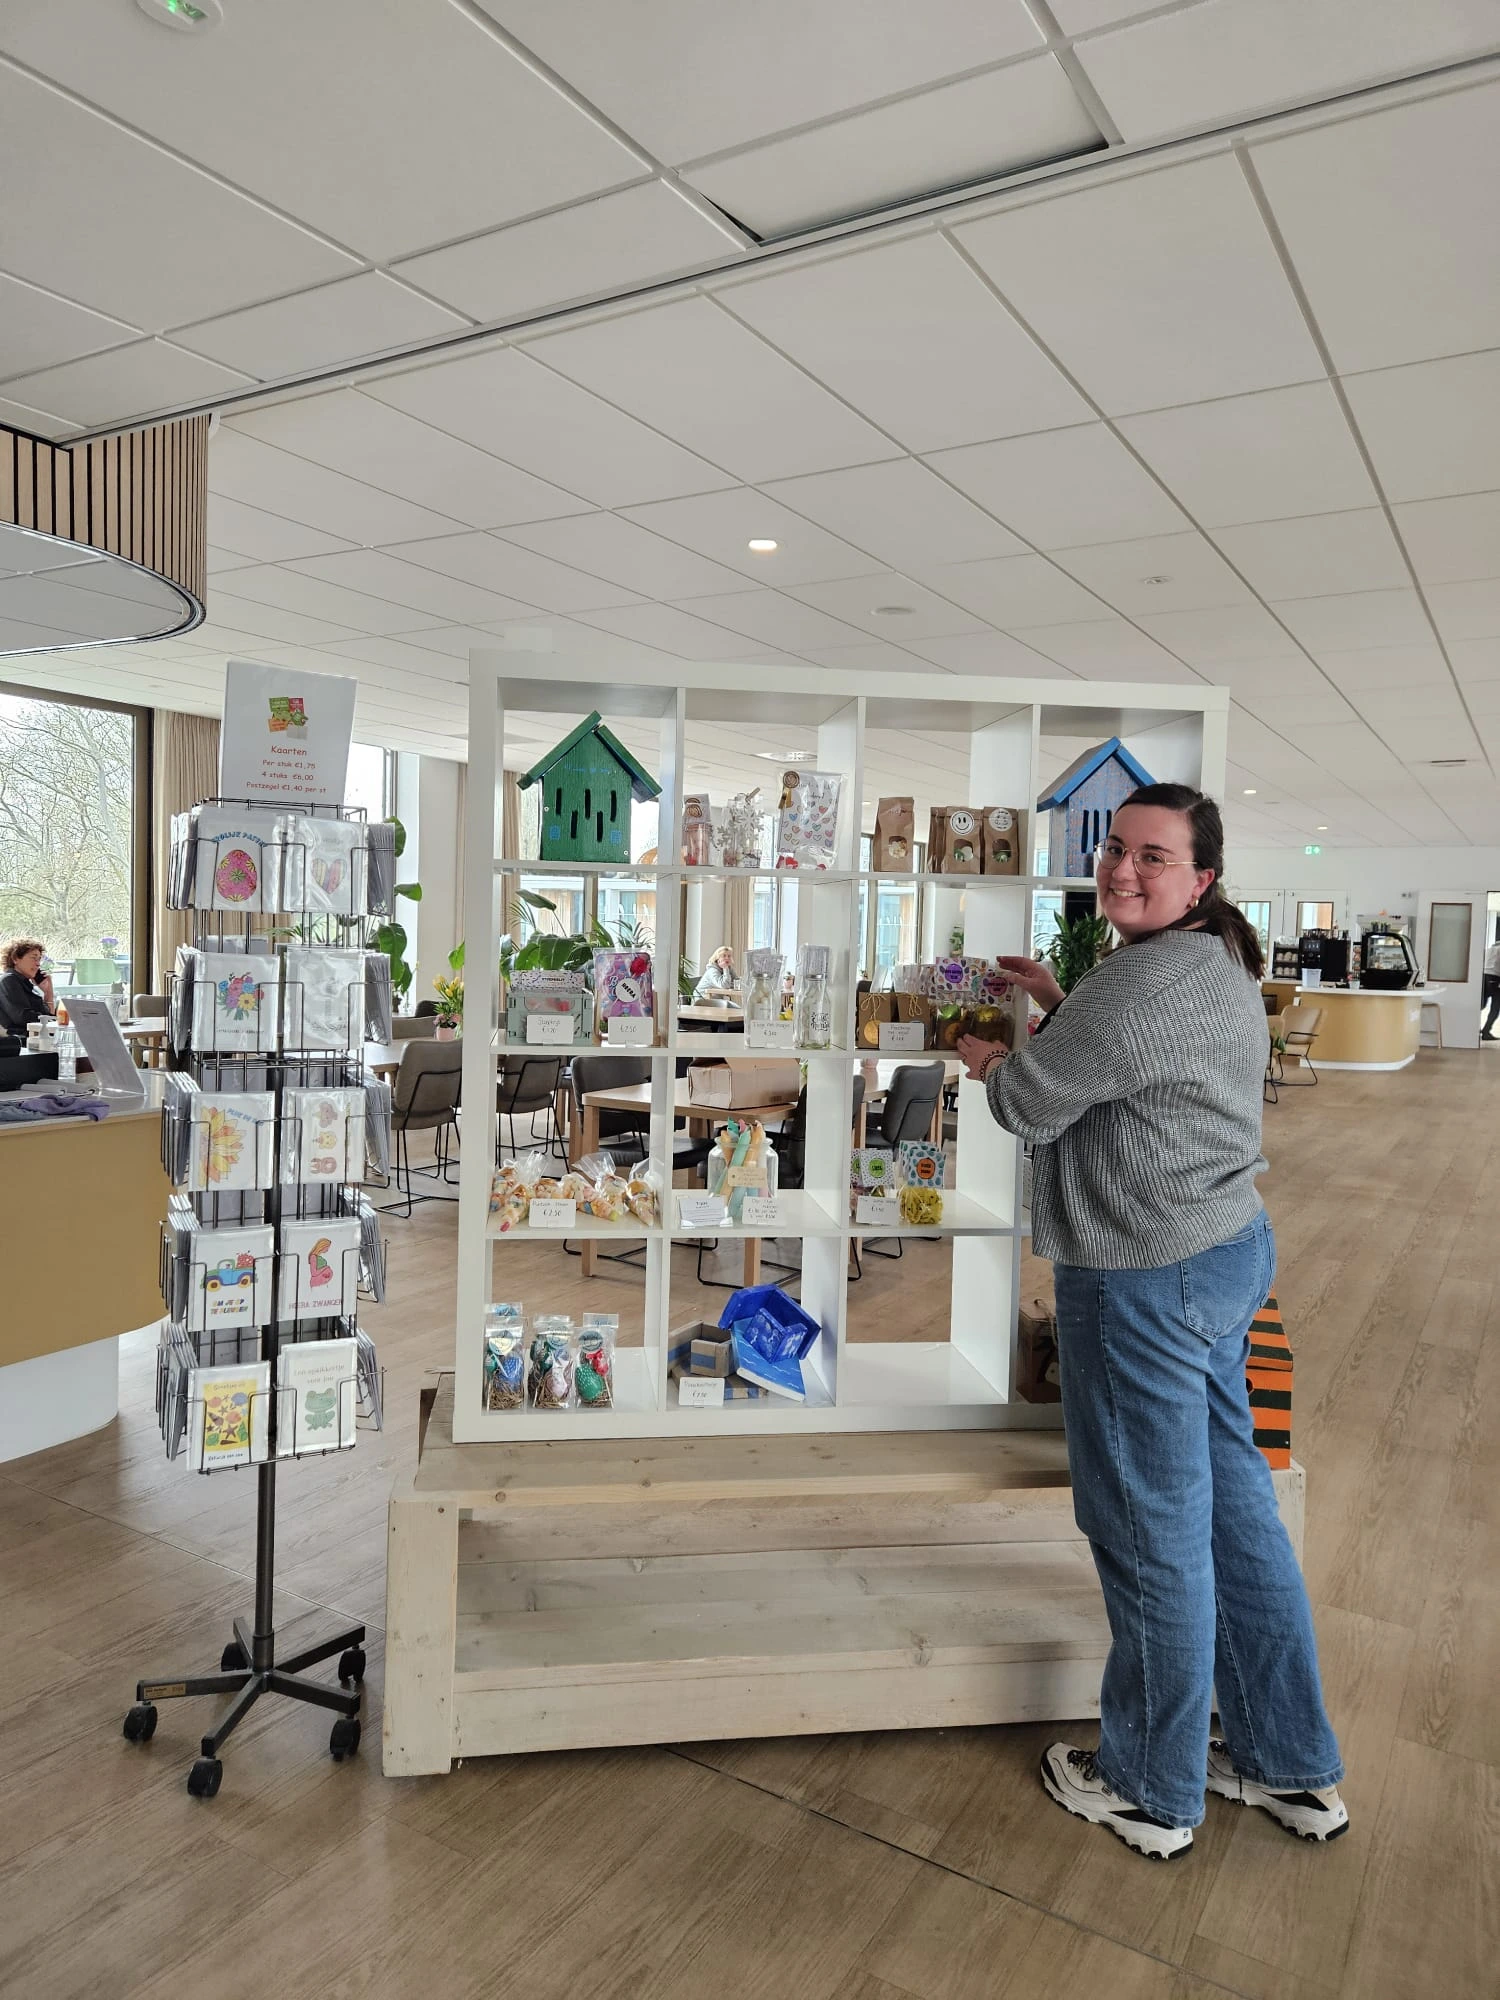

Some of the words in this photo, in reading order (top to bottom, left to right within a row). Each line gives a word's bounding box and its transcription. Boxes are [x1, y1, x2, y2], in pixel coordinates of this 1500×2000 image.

[271, 745, 307, 756] Kaarten
[246, 781, 280, 791] Postzegel
[621, 982, 637, 999] HOERA
